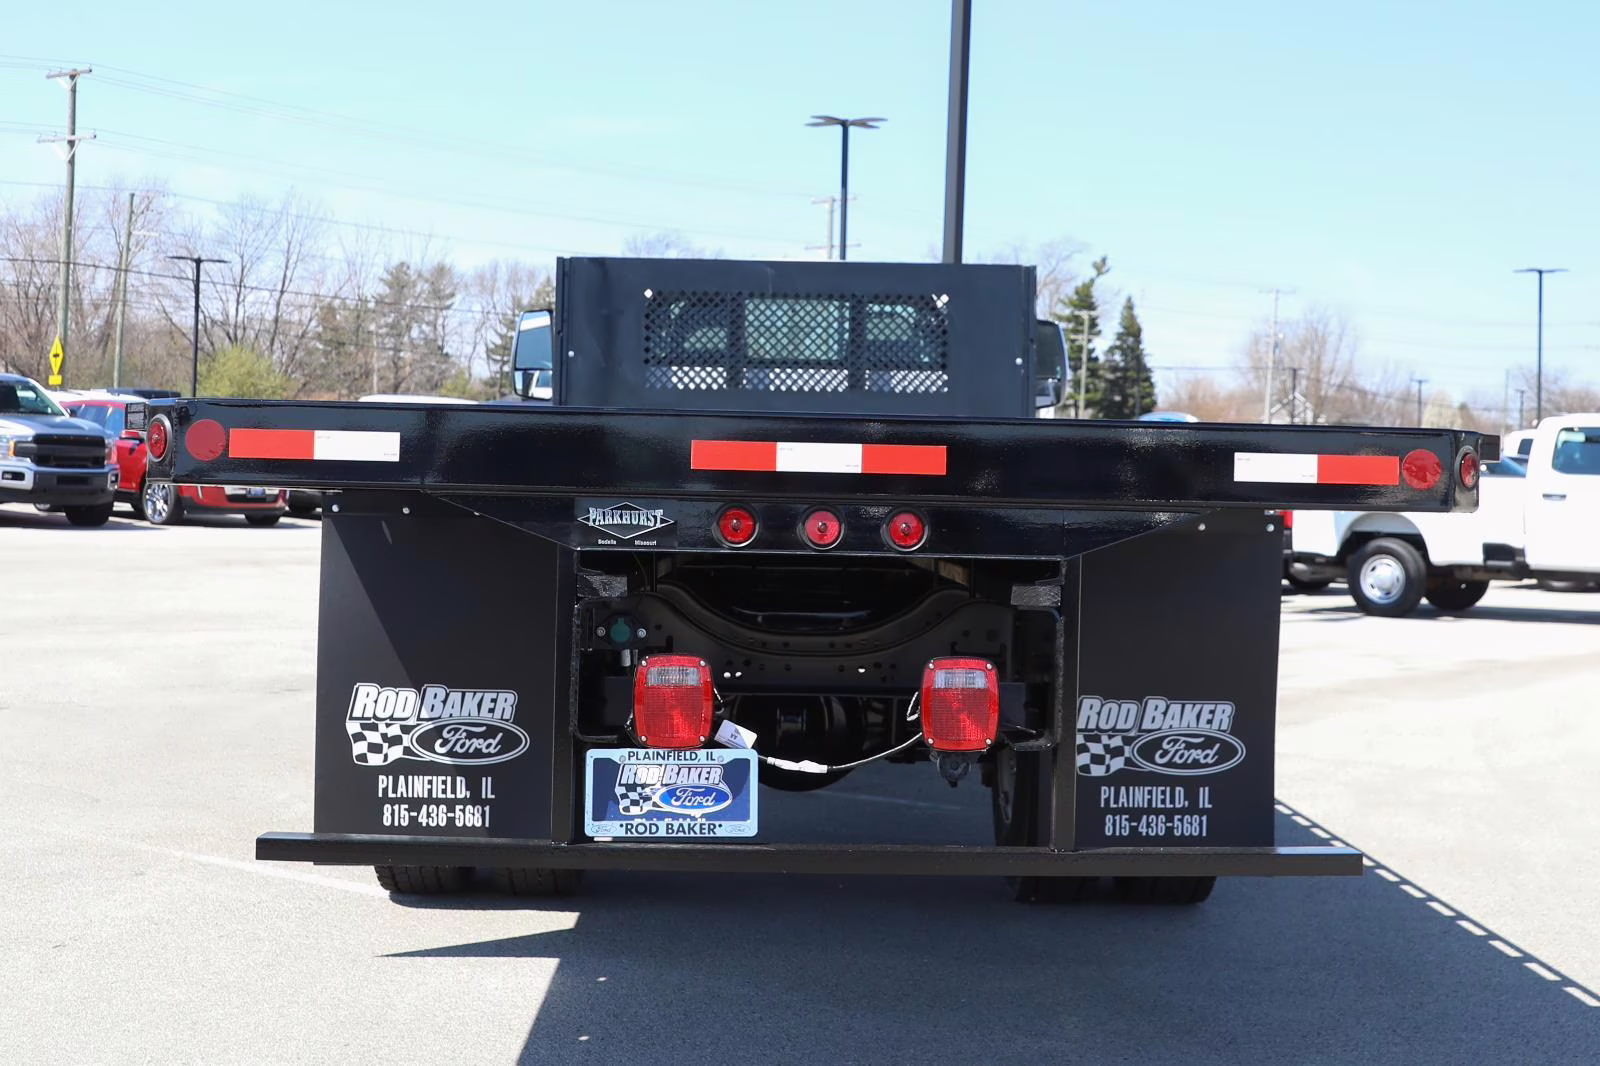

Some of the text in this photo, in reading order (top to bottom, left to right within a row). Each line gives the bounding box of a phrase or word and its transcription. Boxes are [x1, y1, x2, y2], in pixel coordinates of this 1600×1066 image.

[589, 507, 663, 528] PARKHURST
[351, 684, 515, 720] ROD BAKER
[1077, 697, 1233, 731] ROD BAKER
[434, 724, 503, 754] Ford
[1154, 735, 1221, 765] Ford
[627, 750, 716, 763] PLAINFIELD, IL
[620, 764, 722, 785] ROD BAKER
[378, 775, 496, 799] PLAINFIELD, IL
[670, 787, 716, 807] Ford
[1100, 785, 1213, 809] PLAINFIELD, IL
[382, 804, 490, 828] 815-436-5681
[1104, 814, 1208, 837] 815-436-5681
[624, 822, 717, 836] ROD BAKER
